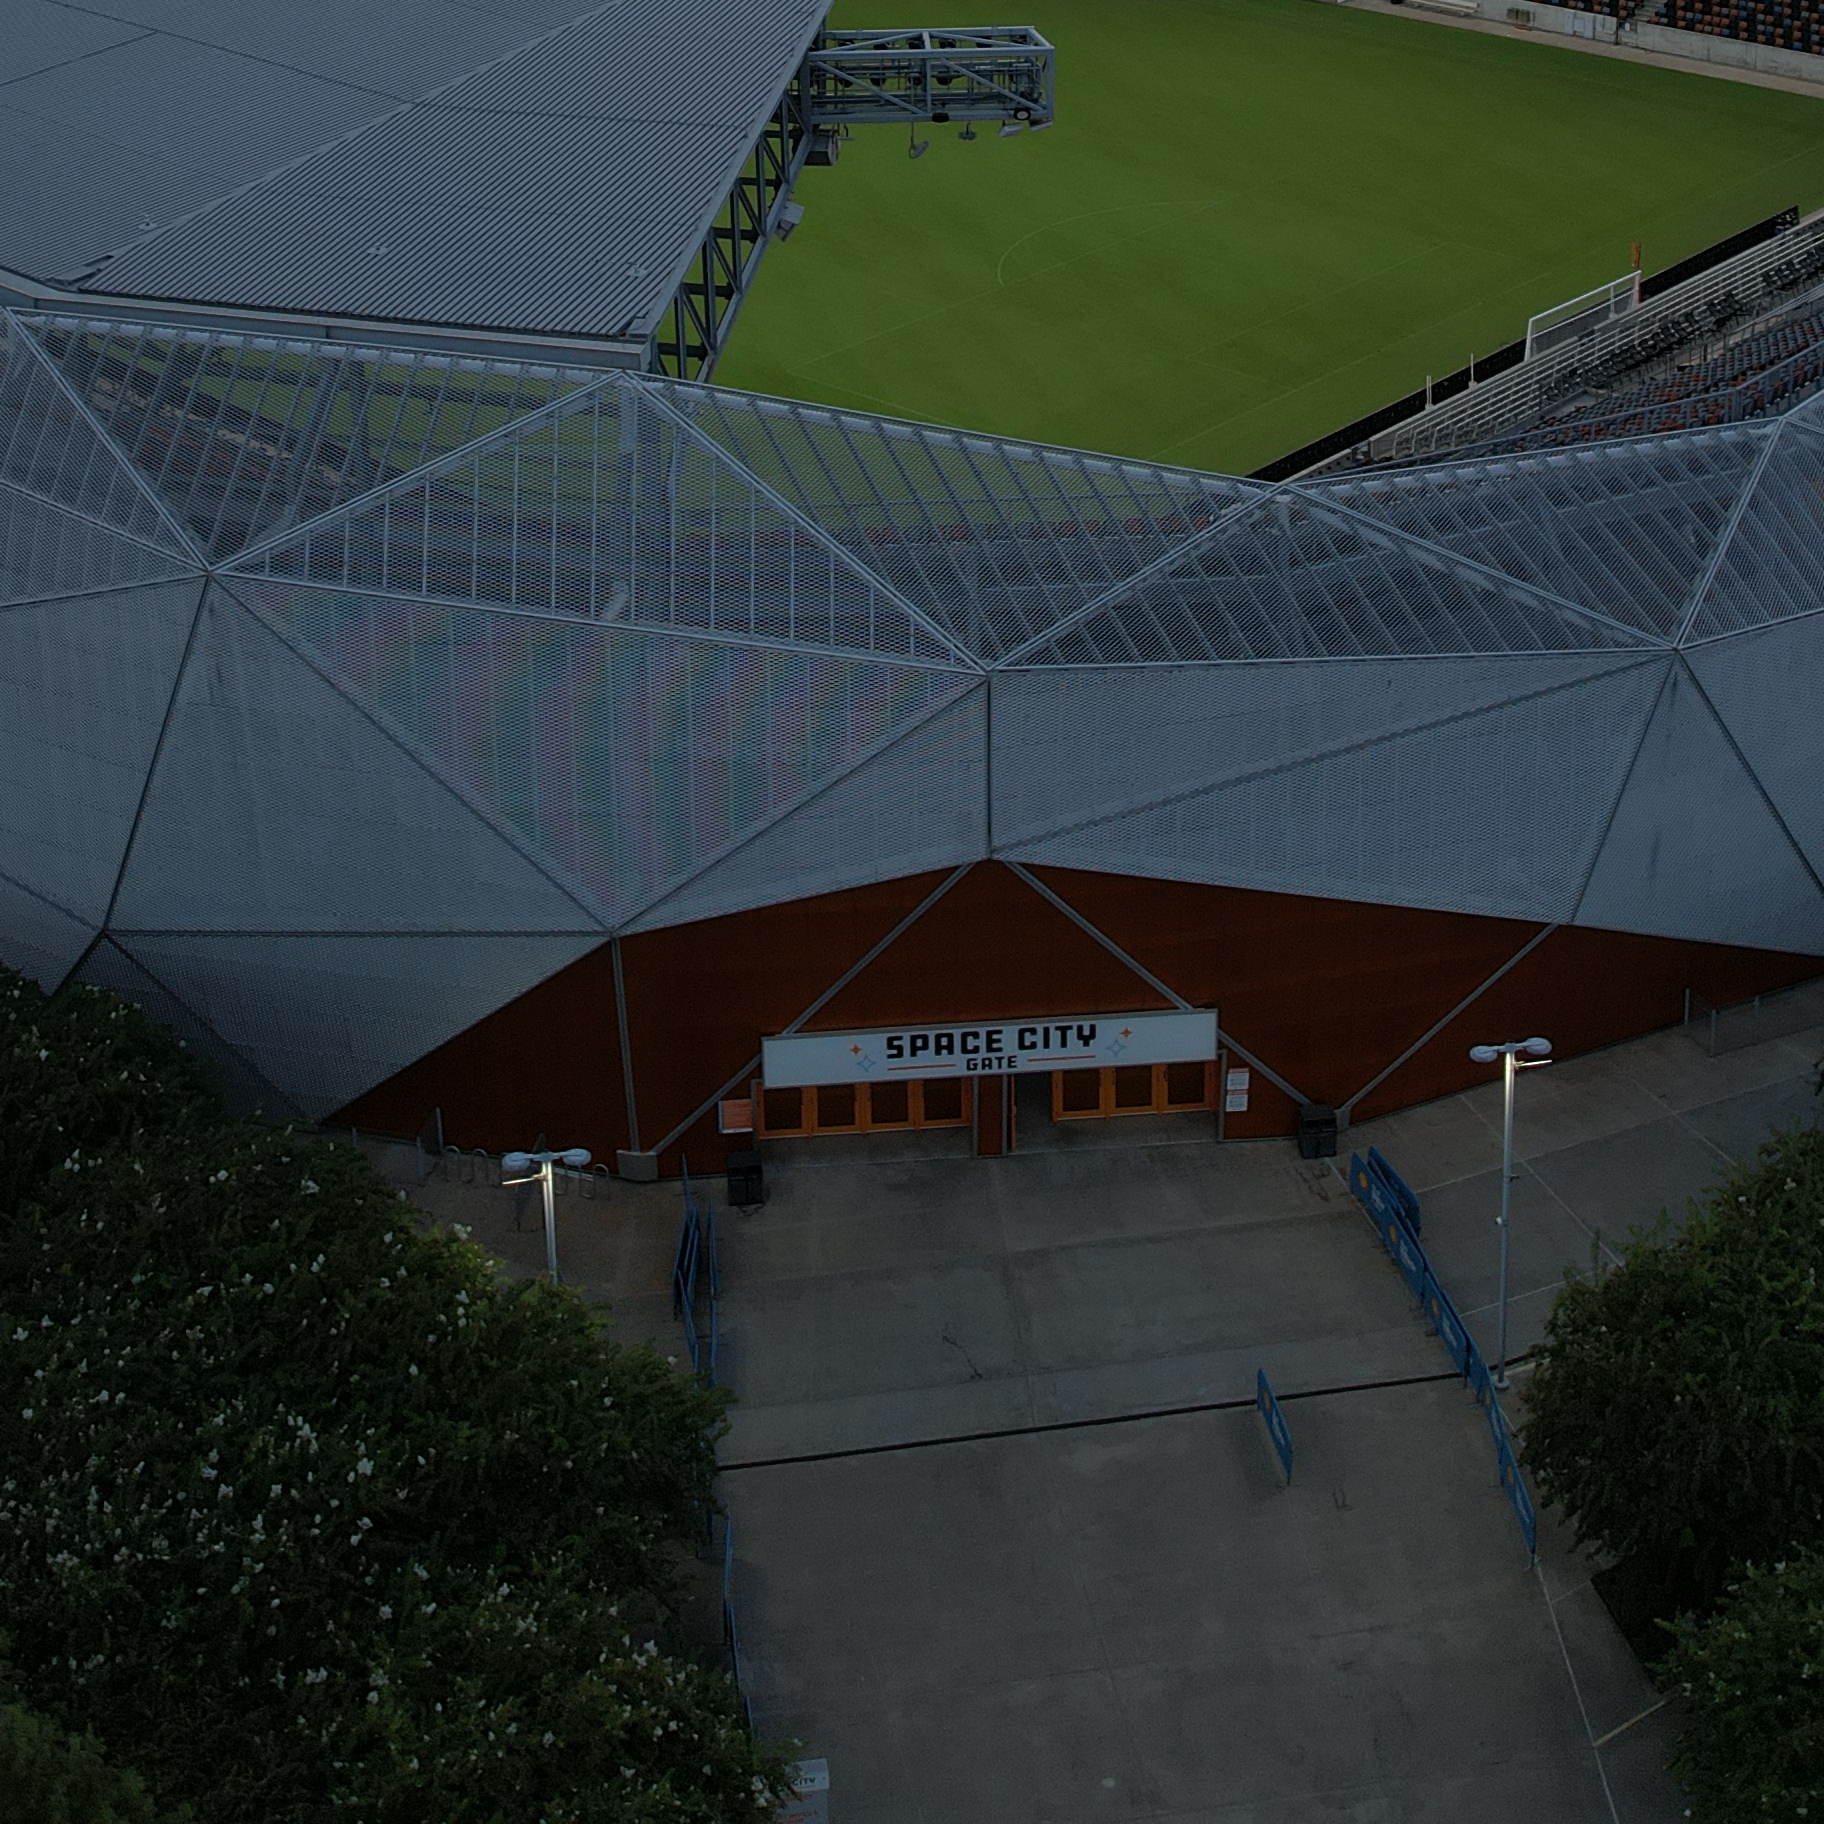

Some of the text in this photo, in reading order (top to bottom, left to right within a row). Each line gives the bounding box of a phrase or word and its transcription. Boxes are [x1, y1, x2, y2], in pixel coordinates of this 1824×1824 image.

[887, 1024, 1097, 1059] SPACE CITY
[966, 1055, 1018, 1071] GATE
